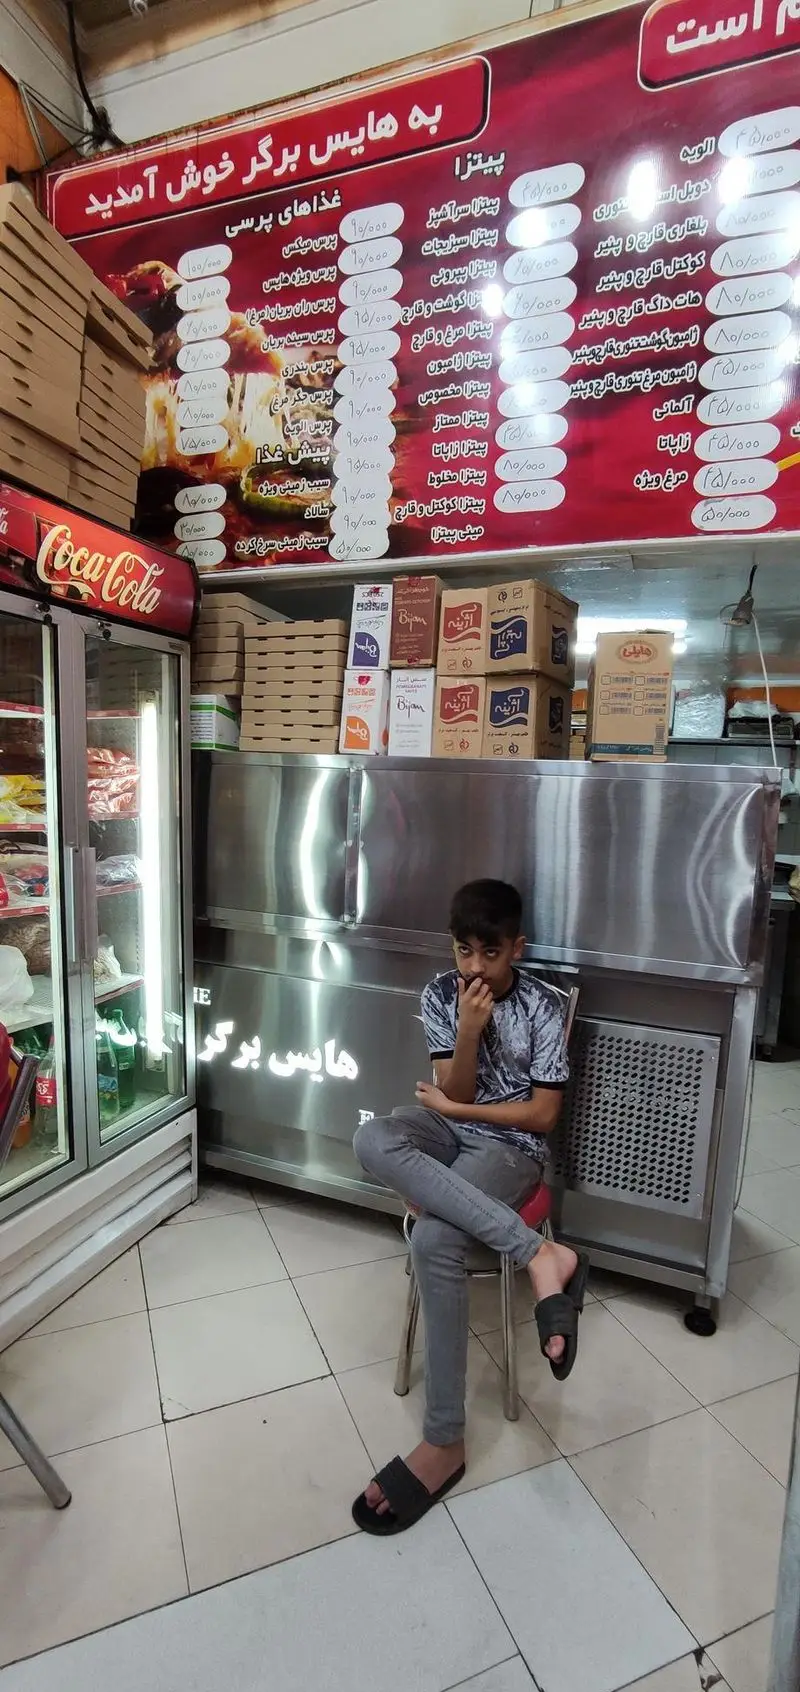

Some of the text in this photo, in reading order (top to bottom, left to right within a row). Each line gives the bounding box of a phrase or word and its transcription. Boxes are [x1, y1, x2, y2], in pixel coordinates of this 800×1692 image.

[680, 136, 715, 162] الویه
[85, 104, 442, 219] به هایس برگر خوش آمدید
[454, 151, 506, 181] پیتزا
[677, 178, 711, 202] دوبل
[225, 190, 341, 238] غذاهای پرسی
[426, 196, 500, 228] پیتزا سرآشپز
[593, 199, 631, 222] نوری
[282, 234, 337, 258] پرس میکس
[421, 228, 499, 257] پیتزا سبزیجات
[594, 236, 623, 258] پنیر
[626, 233, 637, 250] و
[636, 223, 667, 251] قارچ
[263, 265, 337, 292] پرس ویژه هایس
[430, 259, 497, 287] پیتزا پپرونی
[596, 250, 706, 292] کوکتل قارچ و پنیر
[294, 299, 312, 316] ران
[312, 297, 336, 313] پرس
[401, 300, 424, 325] قارچ
[424, 304, 432, 316] و
[434, 291, 469, 312] گوشت
[578, 290, 702, 329] هات داگ قارچ و پنیر
[262, 328, 335, 352] پرس سینه بریان
[411, 329, 435, 352] قارچ
[436, 331, 443, 344] و
[444, 325, 465, 347] مرغ
[466, 321, 493, 338] پیتزا
[281, 359, 334, 378] پرس بندری
[427, 351, 492, 376] پیتزا ژامبون
[271, 387, 333, 413] پرس جگر مرغ
[417, 381, 490, 407] پیتزا مخصوص
[653, 395, 694, 421] آلمانی
[284, 419, 333, 435] پرس الویه
[432, 410, 489, 433] پیتزا ممتاز
[255, 440, 331, 466] پیش غذا
[432, 438, 488, 463] پیتزا زاپاتا
[656, 433, 691, 456] زاپاتا
[708, 432, 760, 452] ۴۵/۰۰۰
[427, 469, 487, 488] پیتزا مخلوط
[503, 459, 545, 475] ۸۰/۰۰۰
[703, 466, 756, 489] ۴۵/۰۰۰
[258, 477, 330, 497] سیب زمینی ویژه
[634, 469, 689, 492] مرغ ویژه
[502, 488, 546, 505] ۸۰/۰۰۰
[304, 503, 329, 519] سالاد
[394, 498, 485, 521] پیتزا کوکتل و قارچ
[701, 506, 750, 522] ۵۰/۰۰۰
[236, 535, 328, 556] سیب زمینی سرخ کرده
[431, 525, 484, 543] مینی پیتزا
[398, 608, 427, 633] Bijan
[396, 695, 426, 719] Bijan
[197, 1020, 359, 1083] هایس برگر
